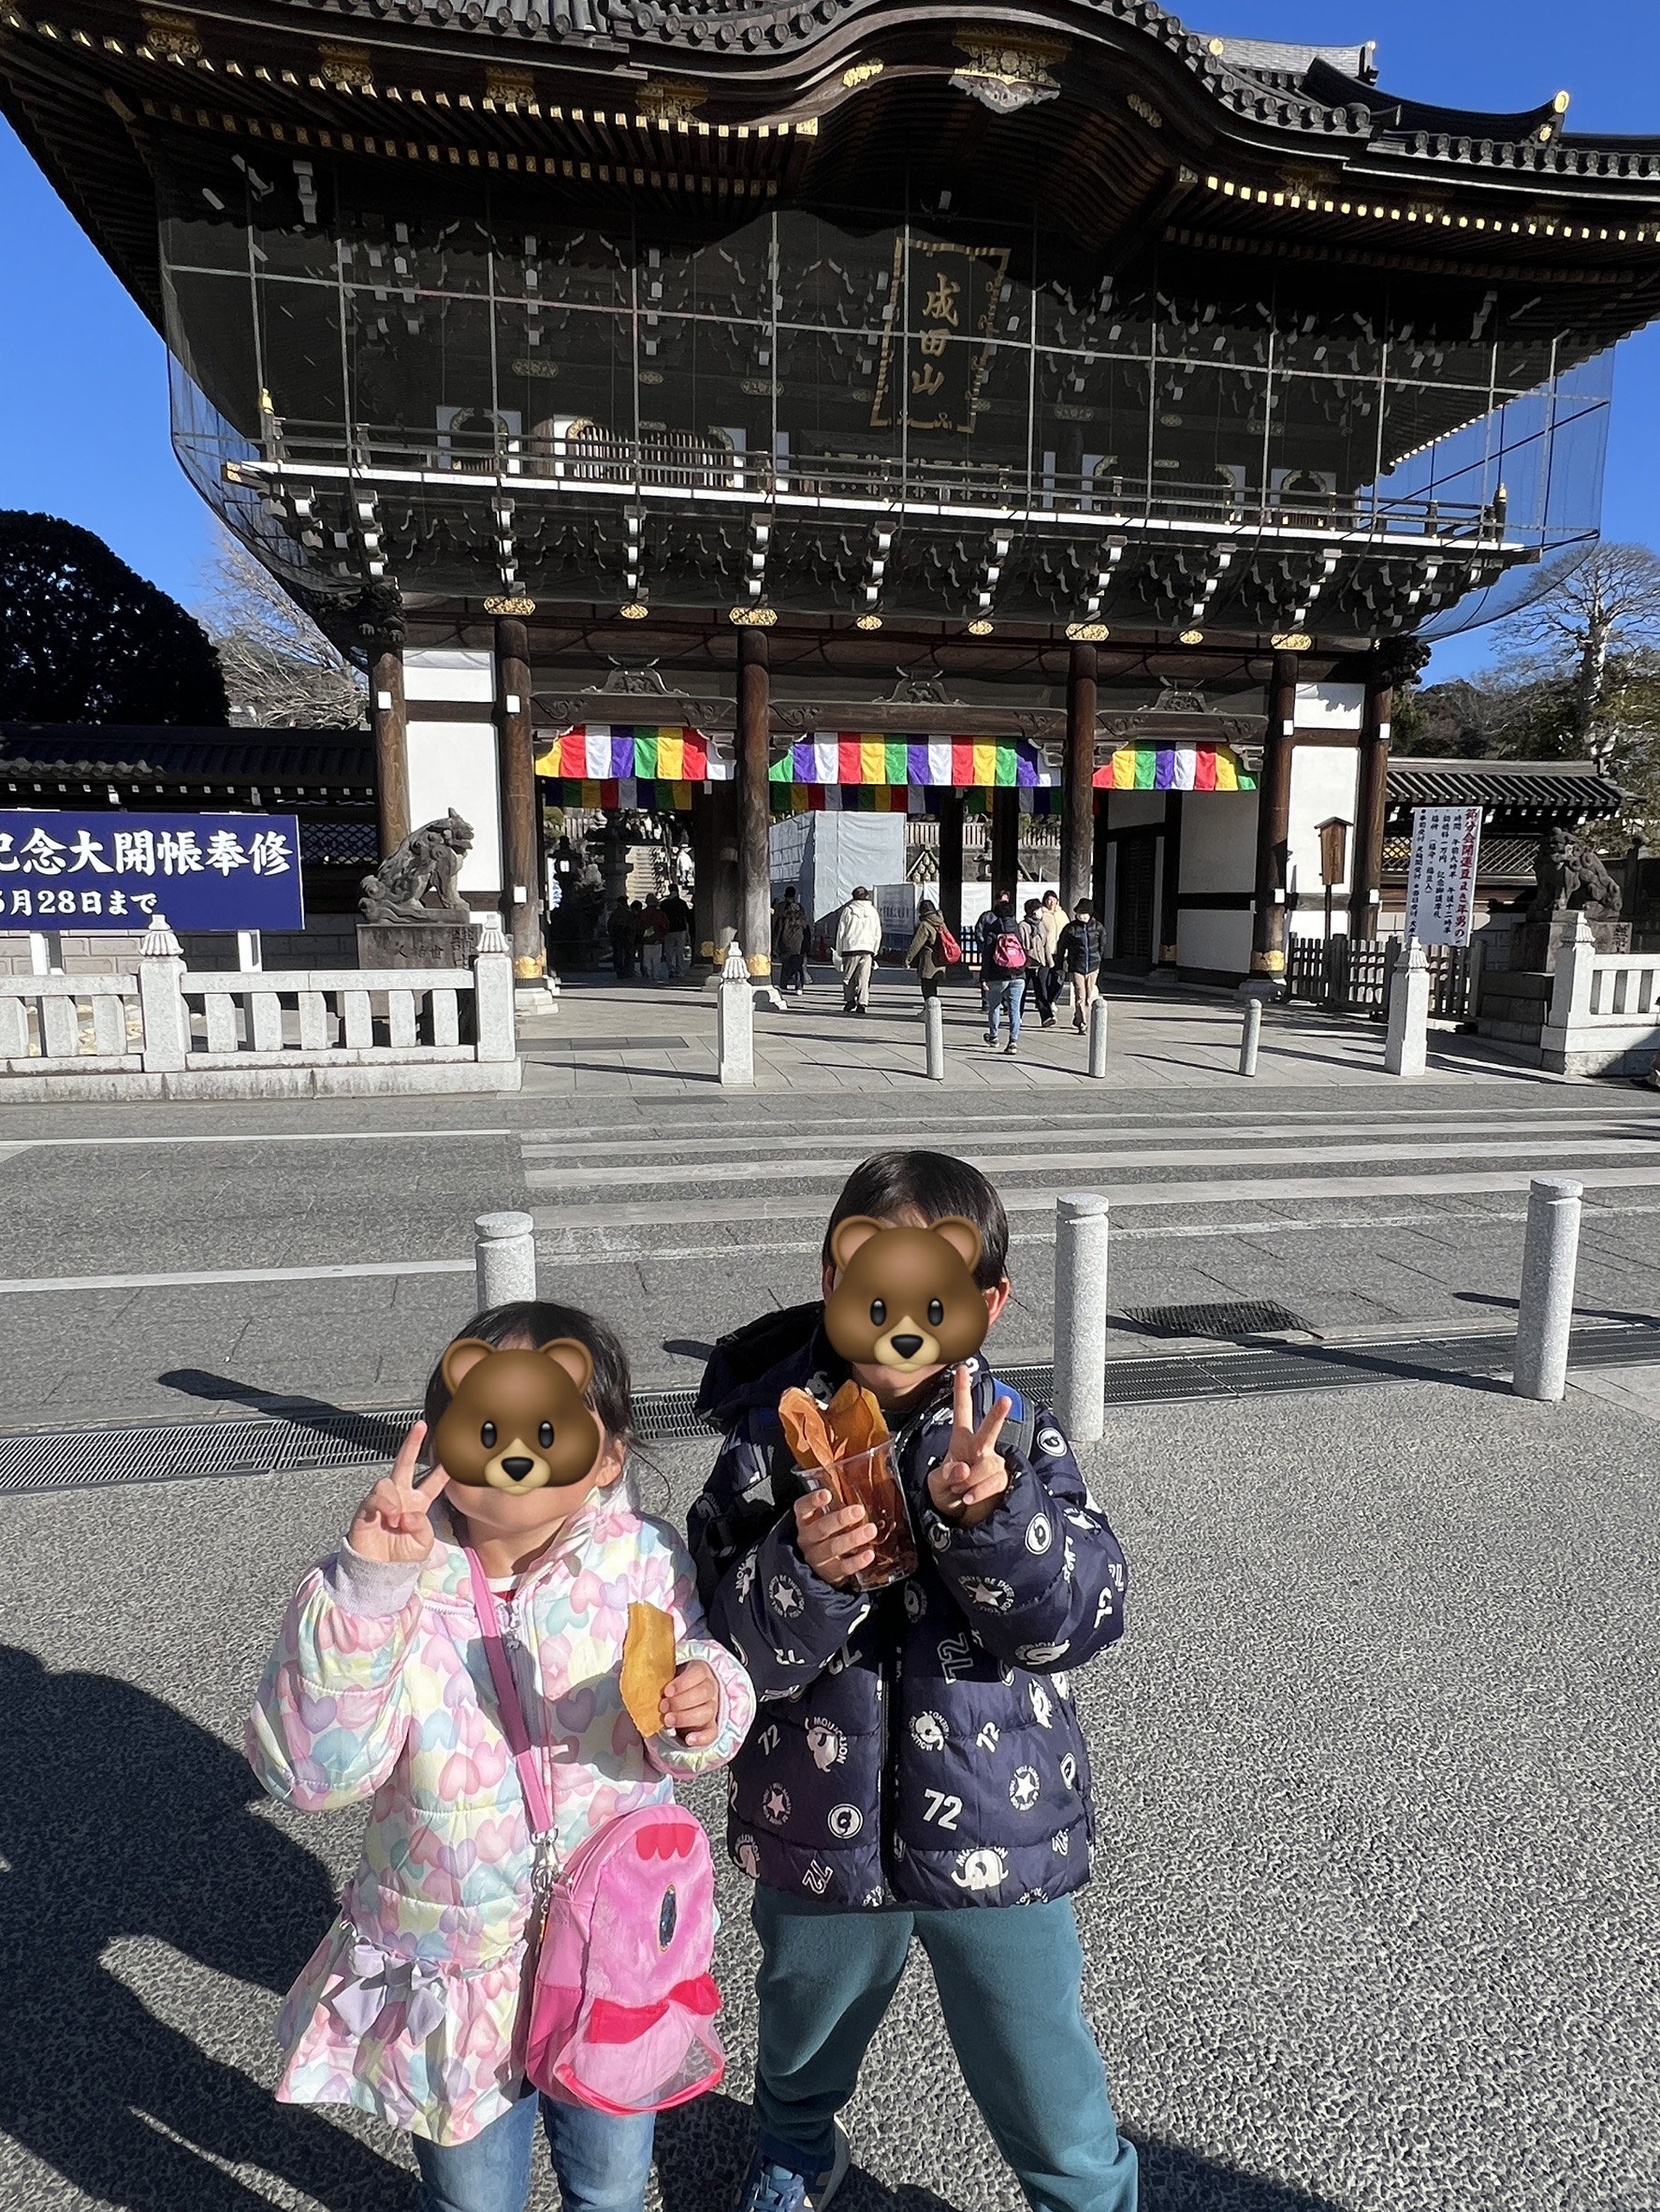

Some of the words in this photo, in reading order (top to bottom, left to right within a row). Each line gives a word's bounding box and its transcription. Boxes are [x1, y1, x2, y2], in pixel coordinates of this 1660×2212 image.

[911, 272, 961, 396] 成田山
[1455, 808, 1478, 943] 節分会開運豆まき年男の
[758, 1724, 780, 1755] 72
[976, 1722, 1000, 1753] 72
[922, 1788, 963, 1831] 72
